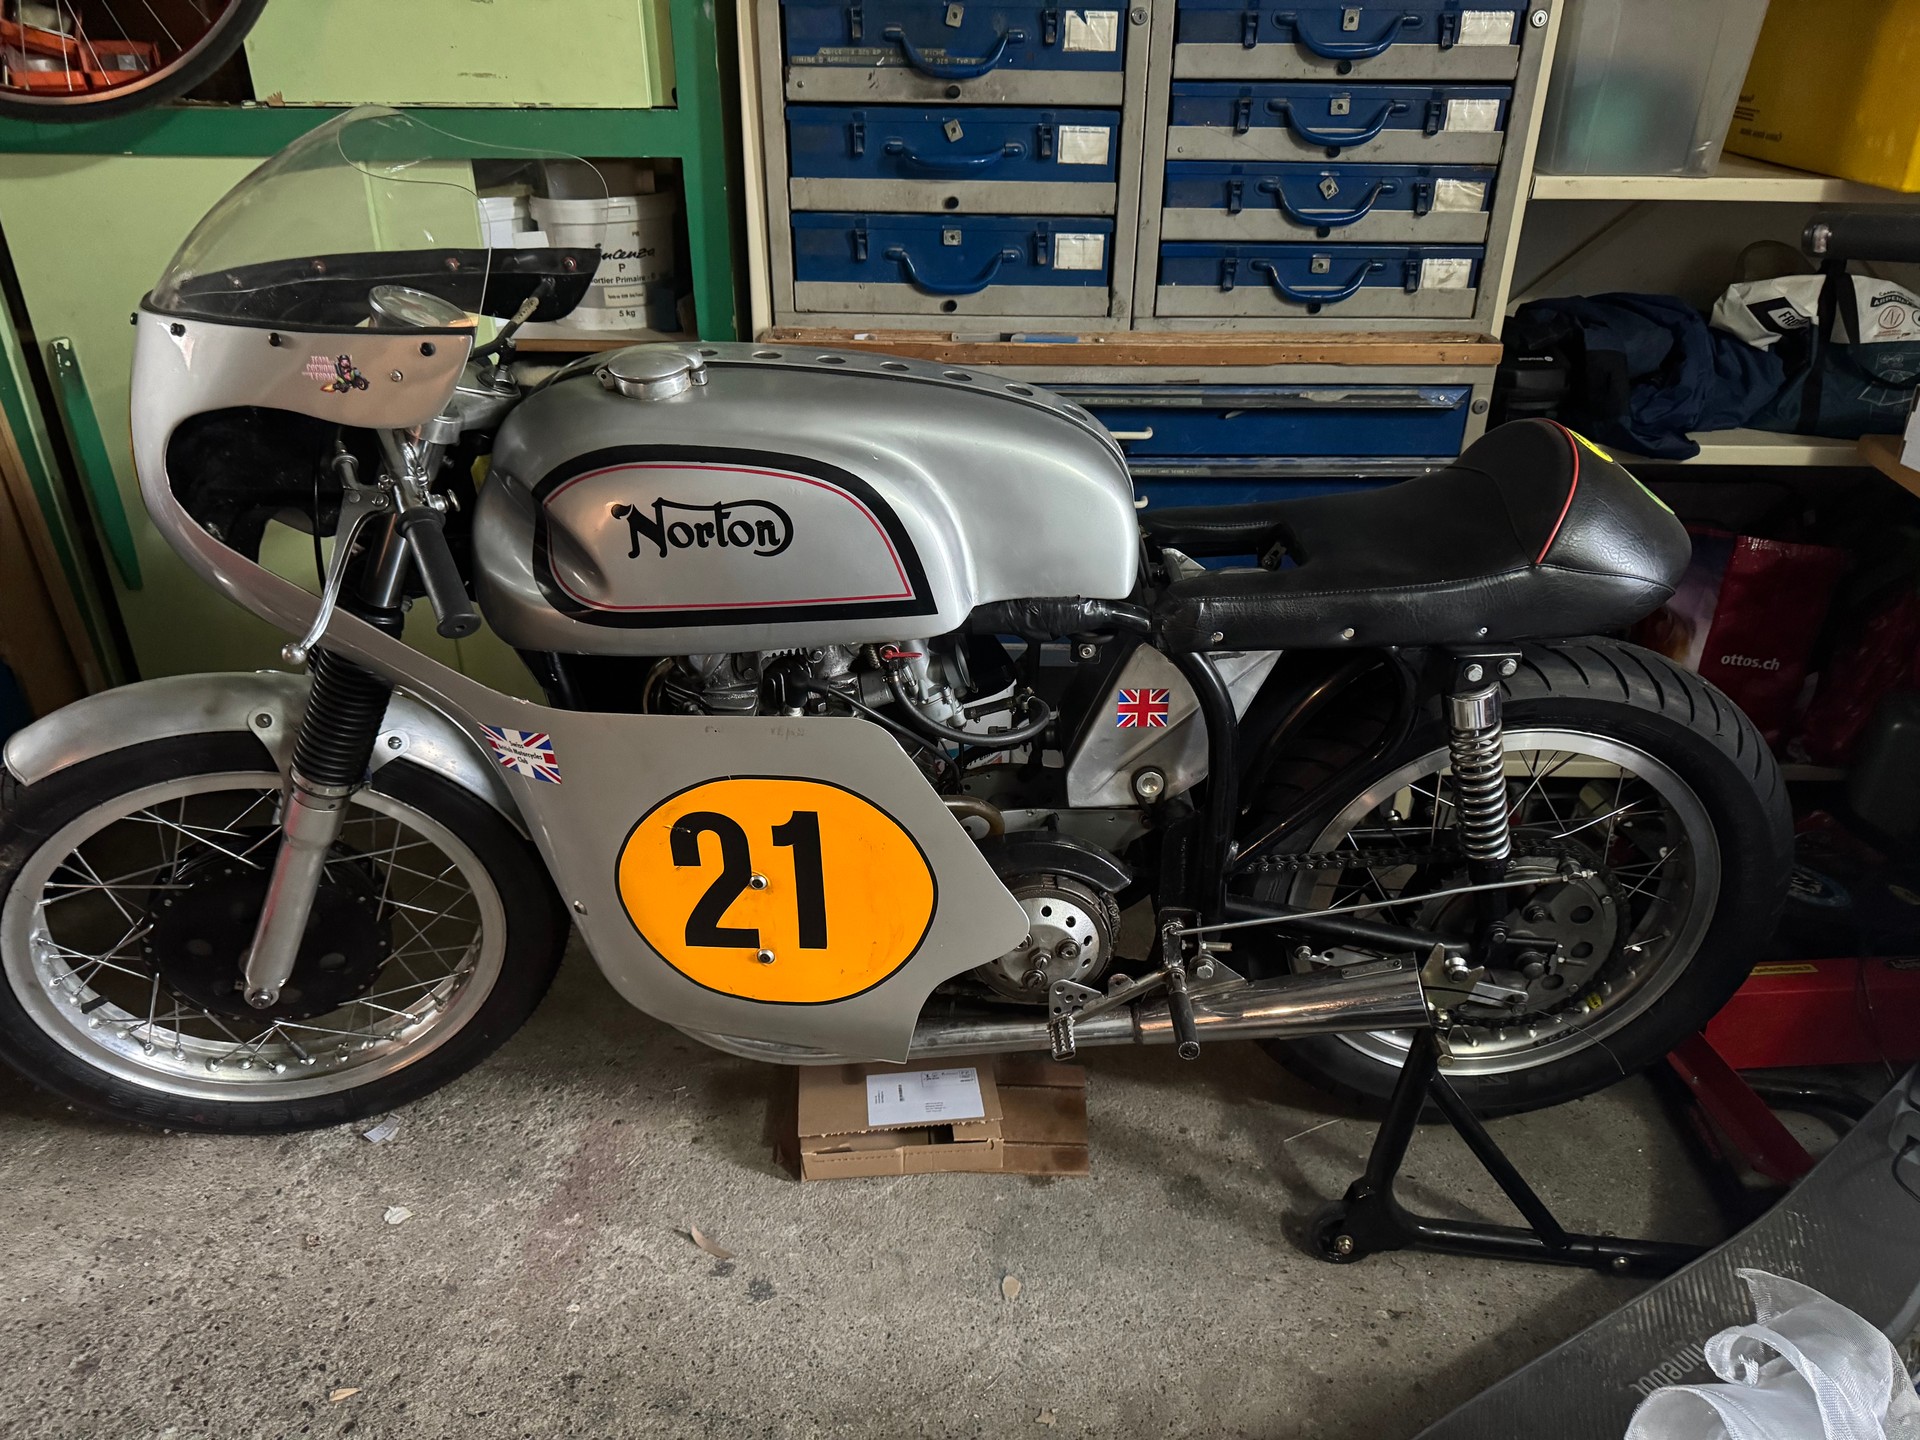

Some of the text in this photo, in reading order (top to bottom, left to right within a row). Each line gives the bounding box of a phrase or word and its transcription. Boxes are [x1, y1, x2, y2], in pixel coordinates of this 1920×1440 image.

[619, 263, 625, 272] P
[616, 273, 646, 283] Primaire
[625, 309, 636, 318] kg
[611, 497, 794, 559] Norton
[1720, 654, 1781, 671] ottos.ch
[669, 810, 828, 950] 21
